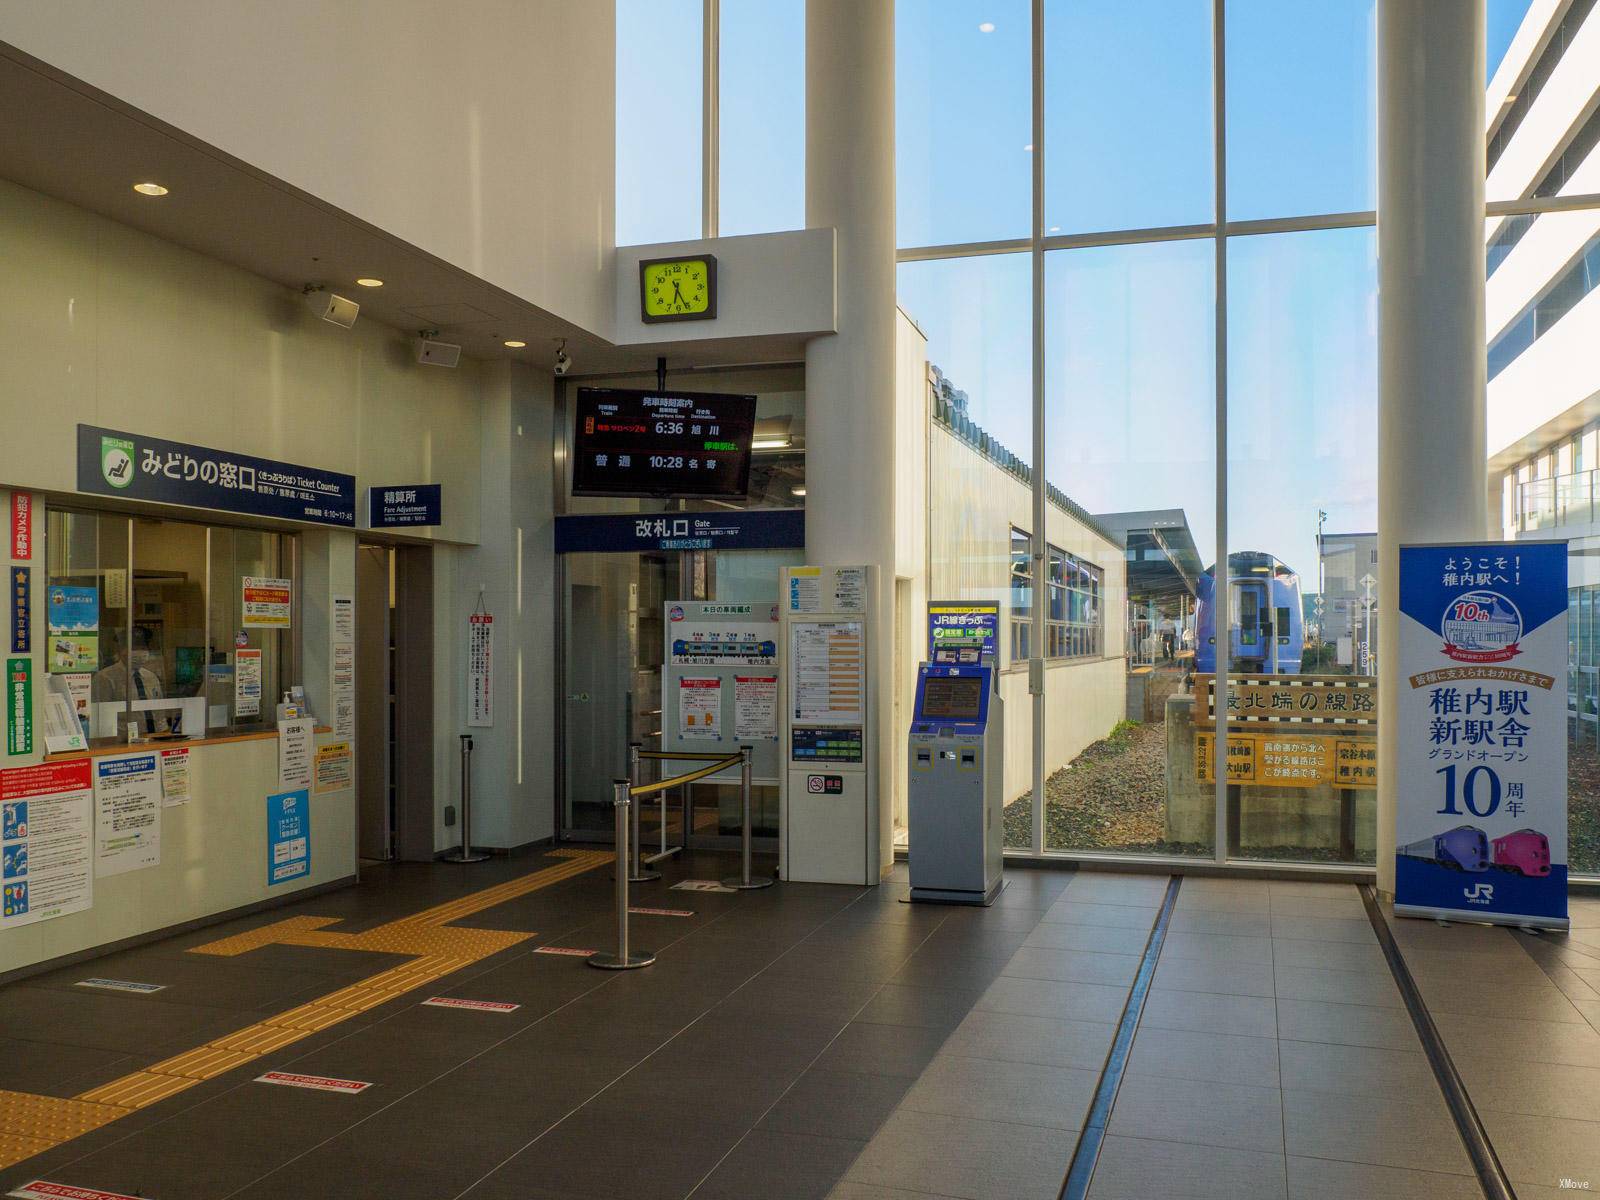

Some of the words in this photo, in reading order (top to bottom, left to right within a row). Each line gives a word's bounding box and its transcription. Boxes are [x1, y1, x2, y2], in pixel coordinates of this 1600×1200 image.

[655, 422, 684, 434] 6:36
[649, 456, 684, 468] 10:28
[142, 448, 256, 492] みどりの窓口
[297, 476, 316, 488] Ticket
[316, 480, 340, 492] Counter
[384, 490, 417, 504] 精算所
[384, 506, 396, 514] Fare
[396, 505, 427, 514] Adjustment
[16, 496, 28, 557] 防犯カメラ作動中
[635, 519, 689, 538] 改札口
[694, 520, 711, 528] Gate
[1444, 556, 1520, 571] ようこそ！
[1442, 572, 1520, 586] 稚内駅へ！
[1455, 602, 1490, 622] 10th
[934, 616, 984, 625] JR線きっぷ
[1416, 669, 1548, 686] 皆様に支えられおかげさまで
[1428, 687, 1531, 716] 稚内駅
[1428, 716, 1531, 748] 新駅舎
[1264, 743, 1326, 752] 最南端から北へ
[1428, 748, 1529, 762] グランドオープン
[1436, 764, 1501, 818] 10
[1505, 782, 1526, 818] 周年
[1464, 884, 1494, 900] JR
